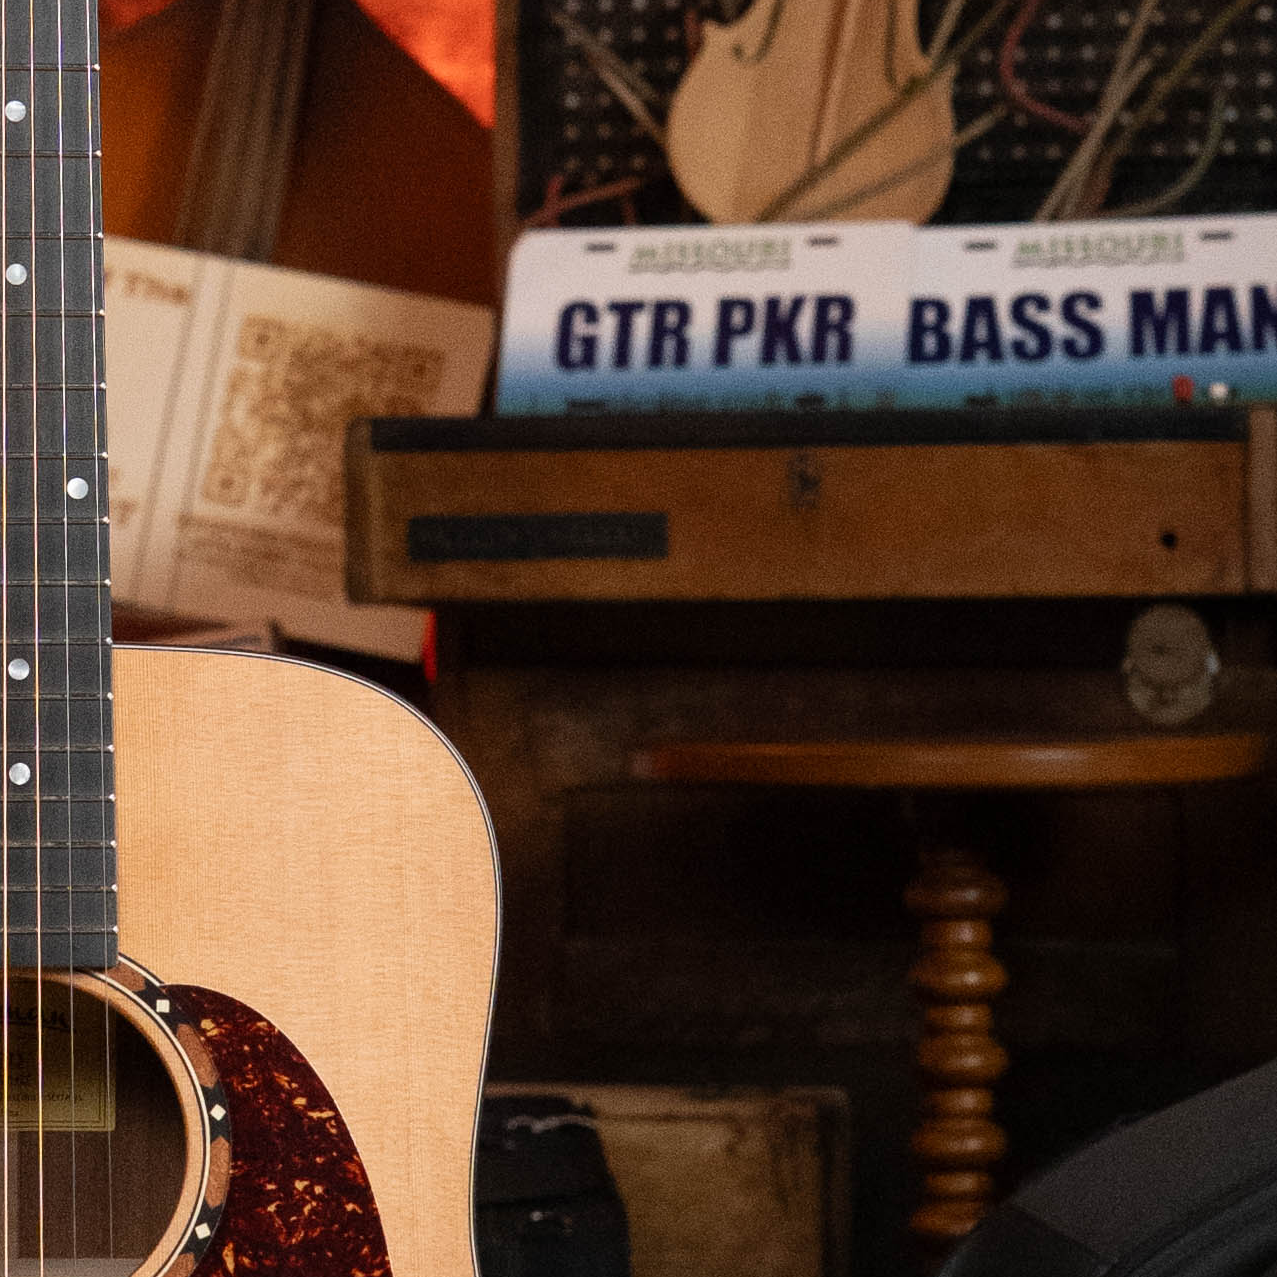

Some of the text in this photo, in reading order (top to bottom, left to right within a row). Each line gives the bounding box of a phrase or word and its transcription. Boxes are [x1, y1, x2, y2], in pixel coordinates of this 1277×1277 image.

[631, 237, 791, 267] MISSOURI
[1013, 232, 1184, 264] MISSOURI
[554, 294, 855, 371] GTR PKR
[908, 290, 1106, 364] BASS
